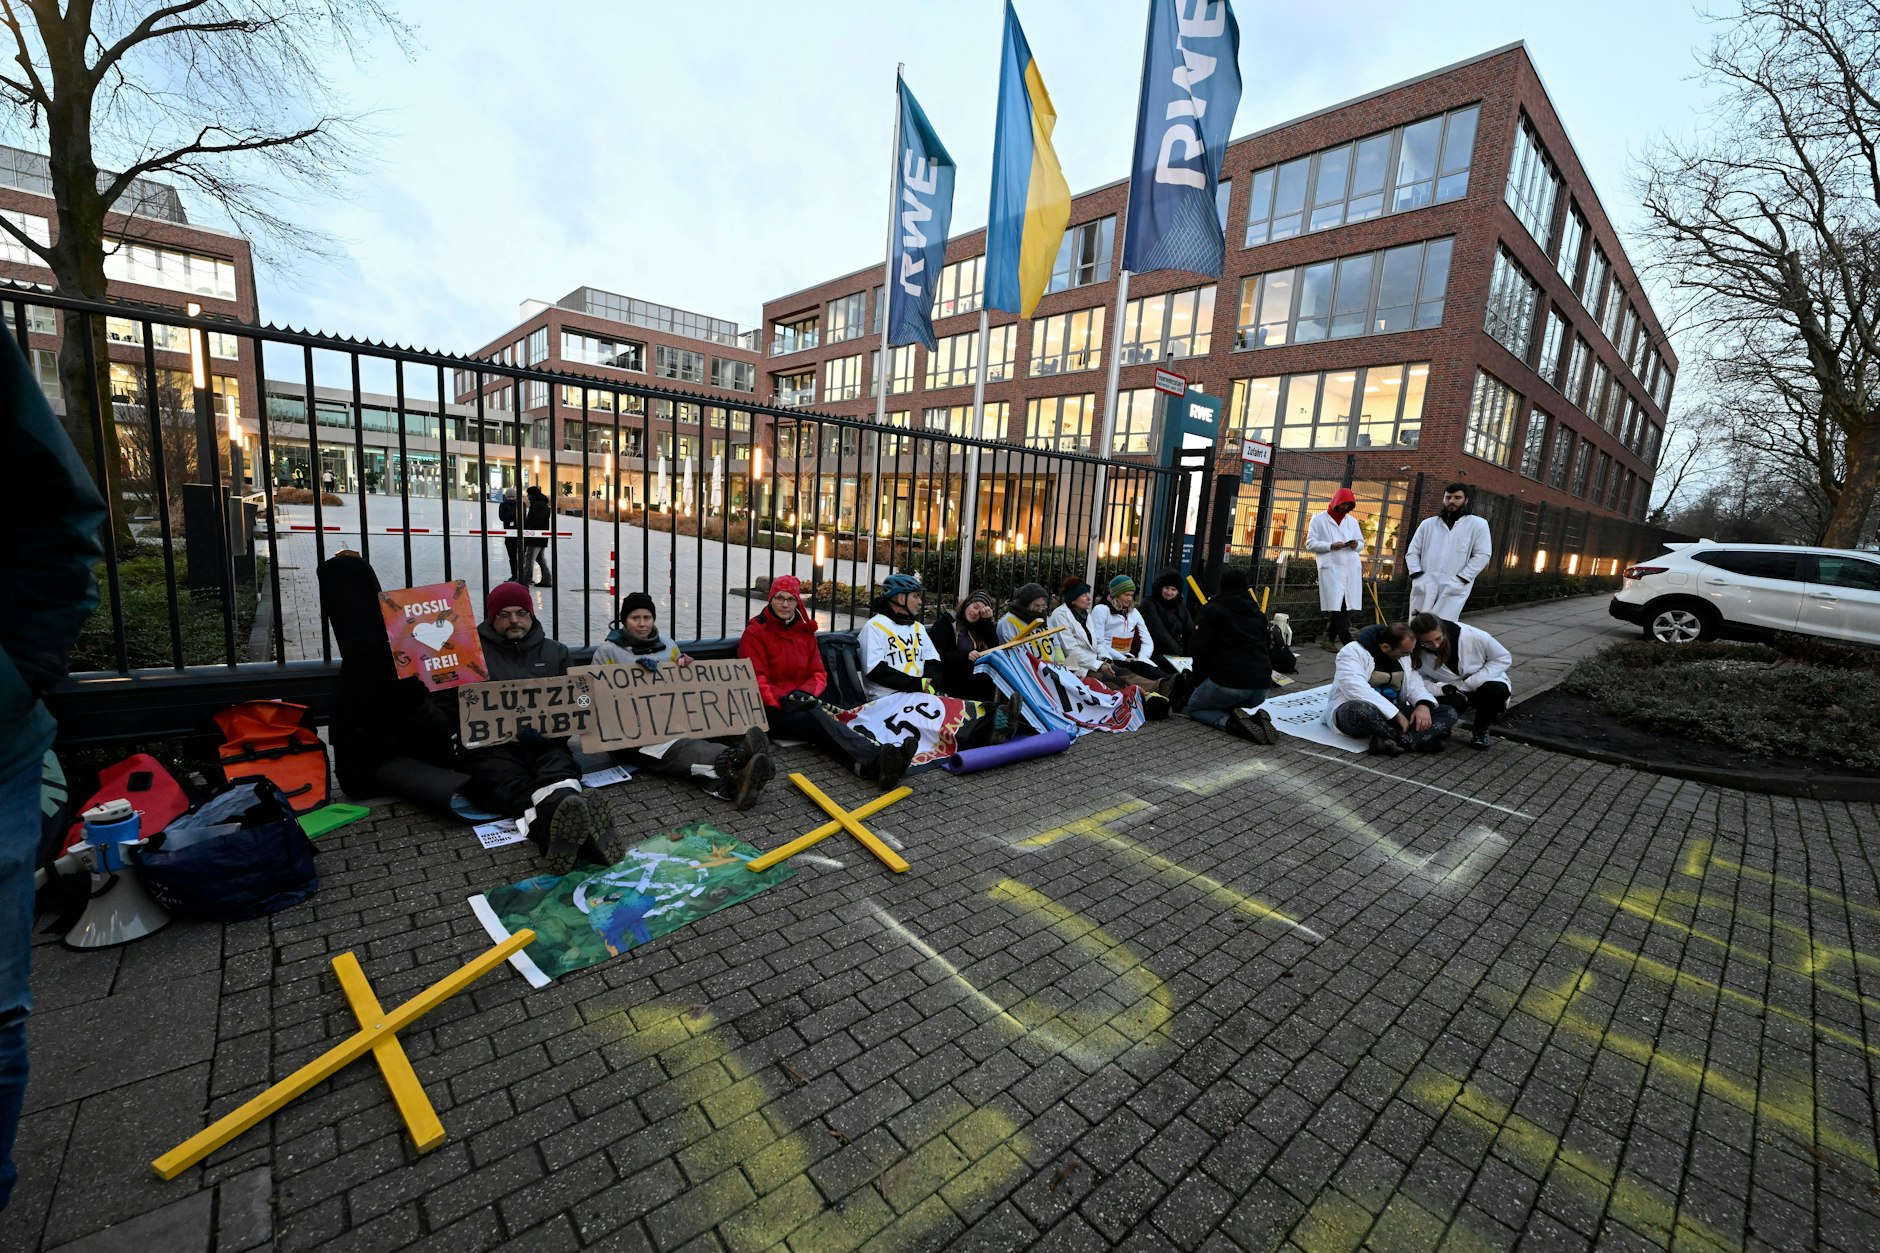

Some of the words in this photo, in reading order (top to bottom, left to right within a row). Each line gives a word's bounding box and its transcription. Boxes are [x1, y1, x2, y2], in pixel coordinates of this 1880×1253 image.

[1154, 0, 1226, 190] RWE
[899, 148, 938, 297] RWE
[1189, 403, 1214, 423] RWE
[1247, 446, 1263, 458] Zufahrt
[403, 598, 452, 618] FOSSIL
[887, 632, 923, 650] RWE
[423, 653, 459, 672] FREI!
[588, 664, 752, 690] MORATORIUM
[481, 679, 576, 711] LÜTZI
[593, 687, 768, 742] LÜTZERATH
